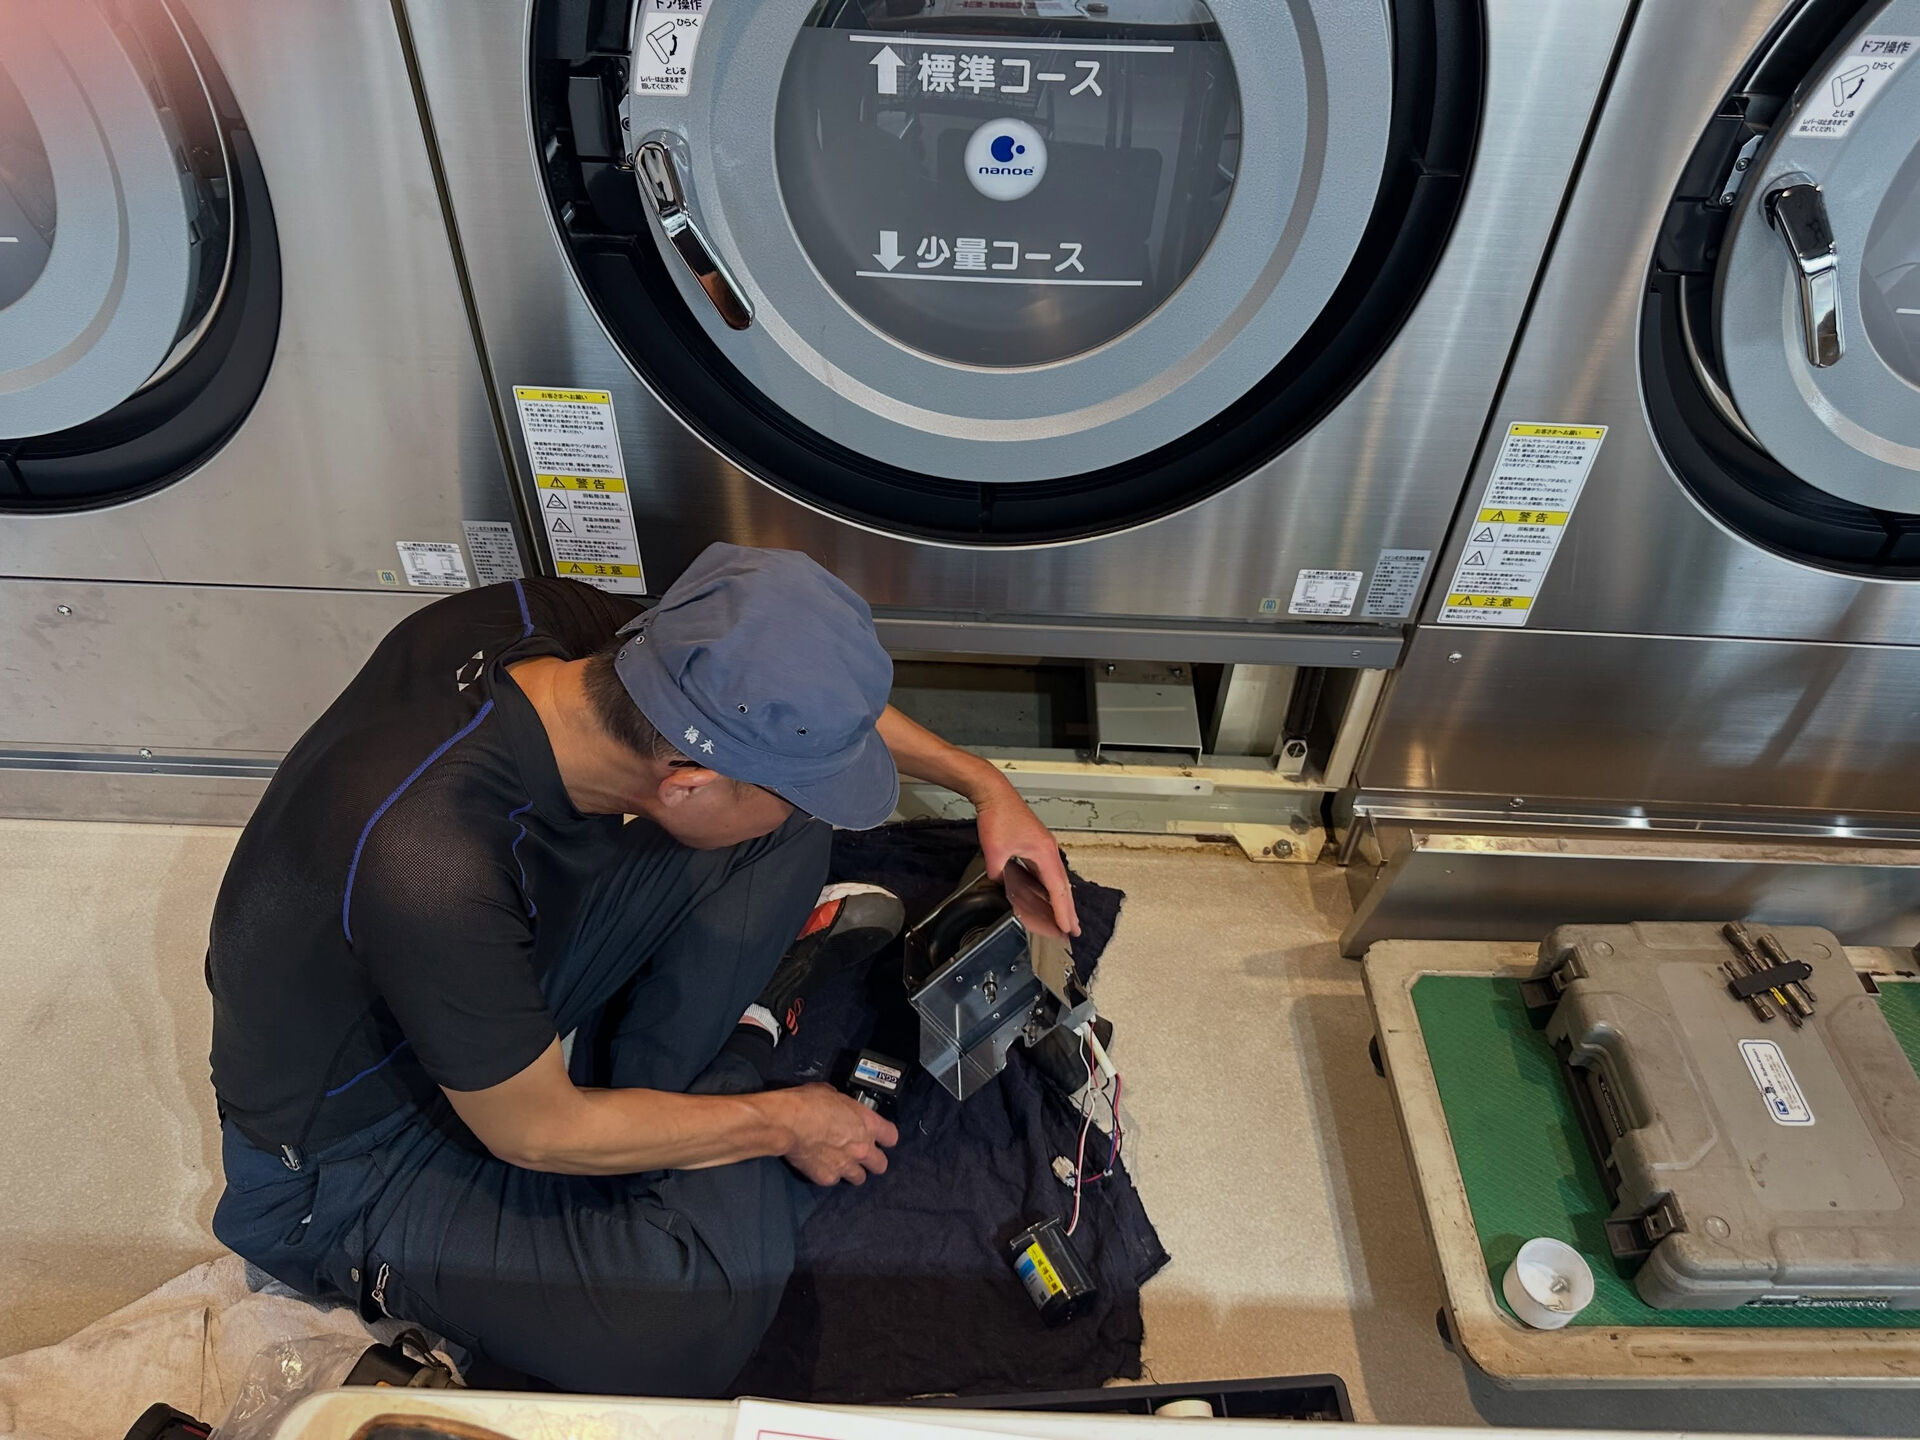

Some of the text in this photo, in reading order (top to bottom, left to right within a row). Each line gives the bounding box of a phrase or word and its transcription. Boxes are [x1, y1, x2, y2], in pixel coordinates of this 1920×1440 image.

[676, 18, 699, 27] ひらく
[1860, 40, 1911, 54] ドア操作
[1871, 61, 1895, 70] ひらく
[665, 67, 687, 75] とじる
[917, 52, 1103, 97] 標準コース
[1832, 110, 1855, 118] とじる
[979, 166, 1034, 176] nanoe
[916, 235, 1084, 273] 少量コース
[576, 478, 606, 489] 警告
[1518, 512, 1549, 523] 警告
[594, 564, 623, 575] 注意
[1483, 597, 1514, 607] 注意
